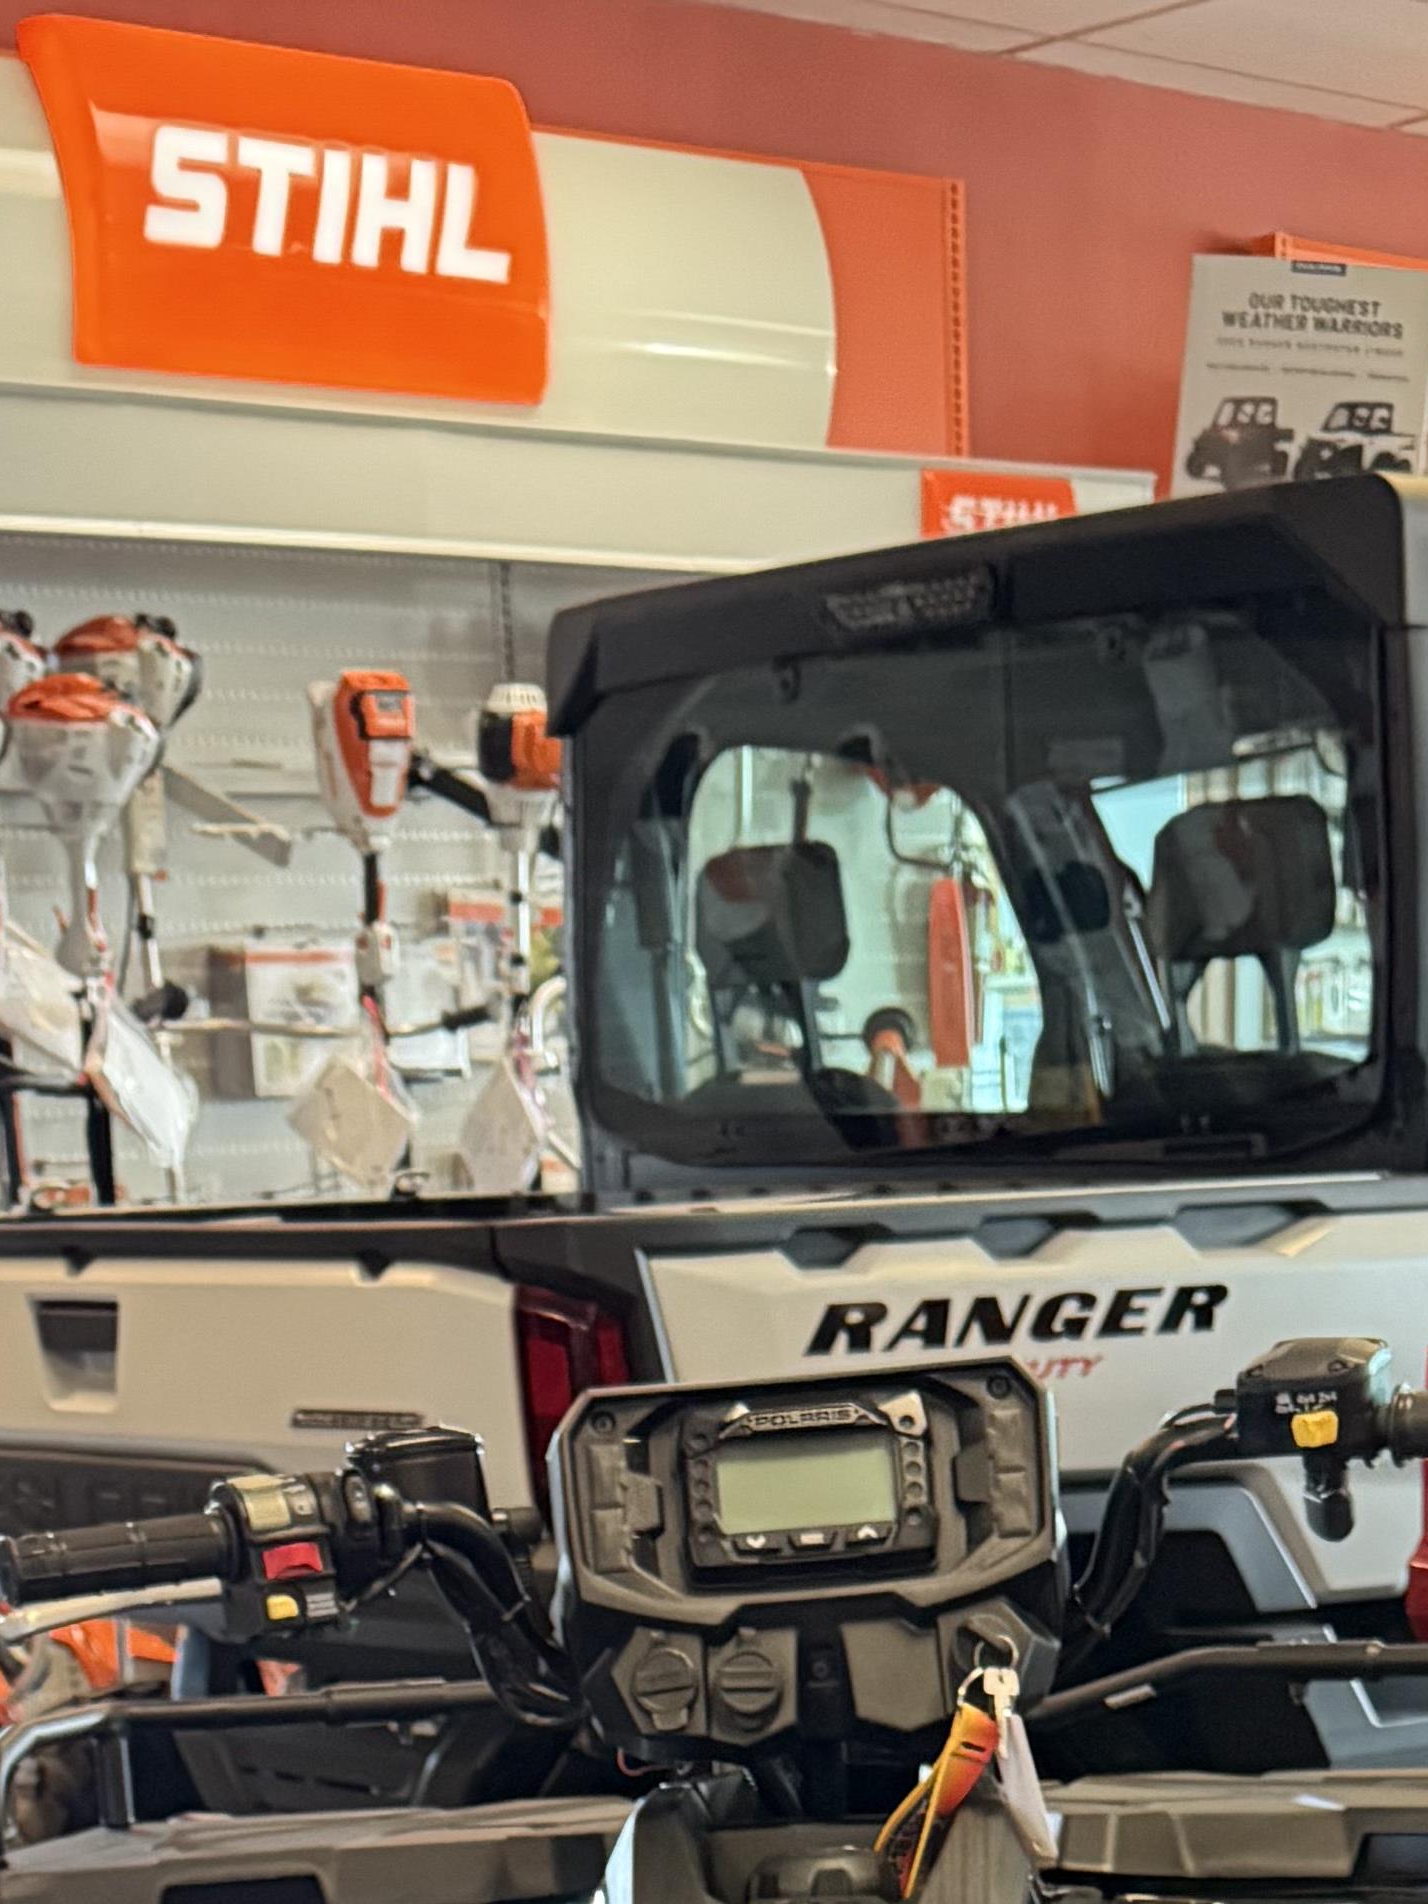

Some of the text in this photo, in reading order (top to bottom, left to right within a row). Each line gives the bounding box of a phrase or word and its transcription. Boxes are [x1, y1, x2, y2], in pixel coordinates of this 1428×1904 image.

[143, 122, 510, 285] STIHL
[1248, 292, 1381, 318] OUR TOUGHEST
[1222, 311, 1404, 340] WEATHER WARRIORS
[805, 1283, 1230, 1357] RANGER
[754, 1408, 852, 1426] POLARIS
